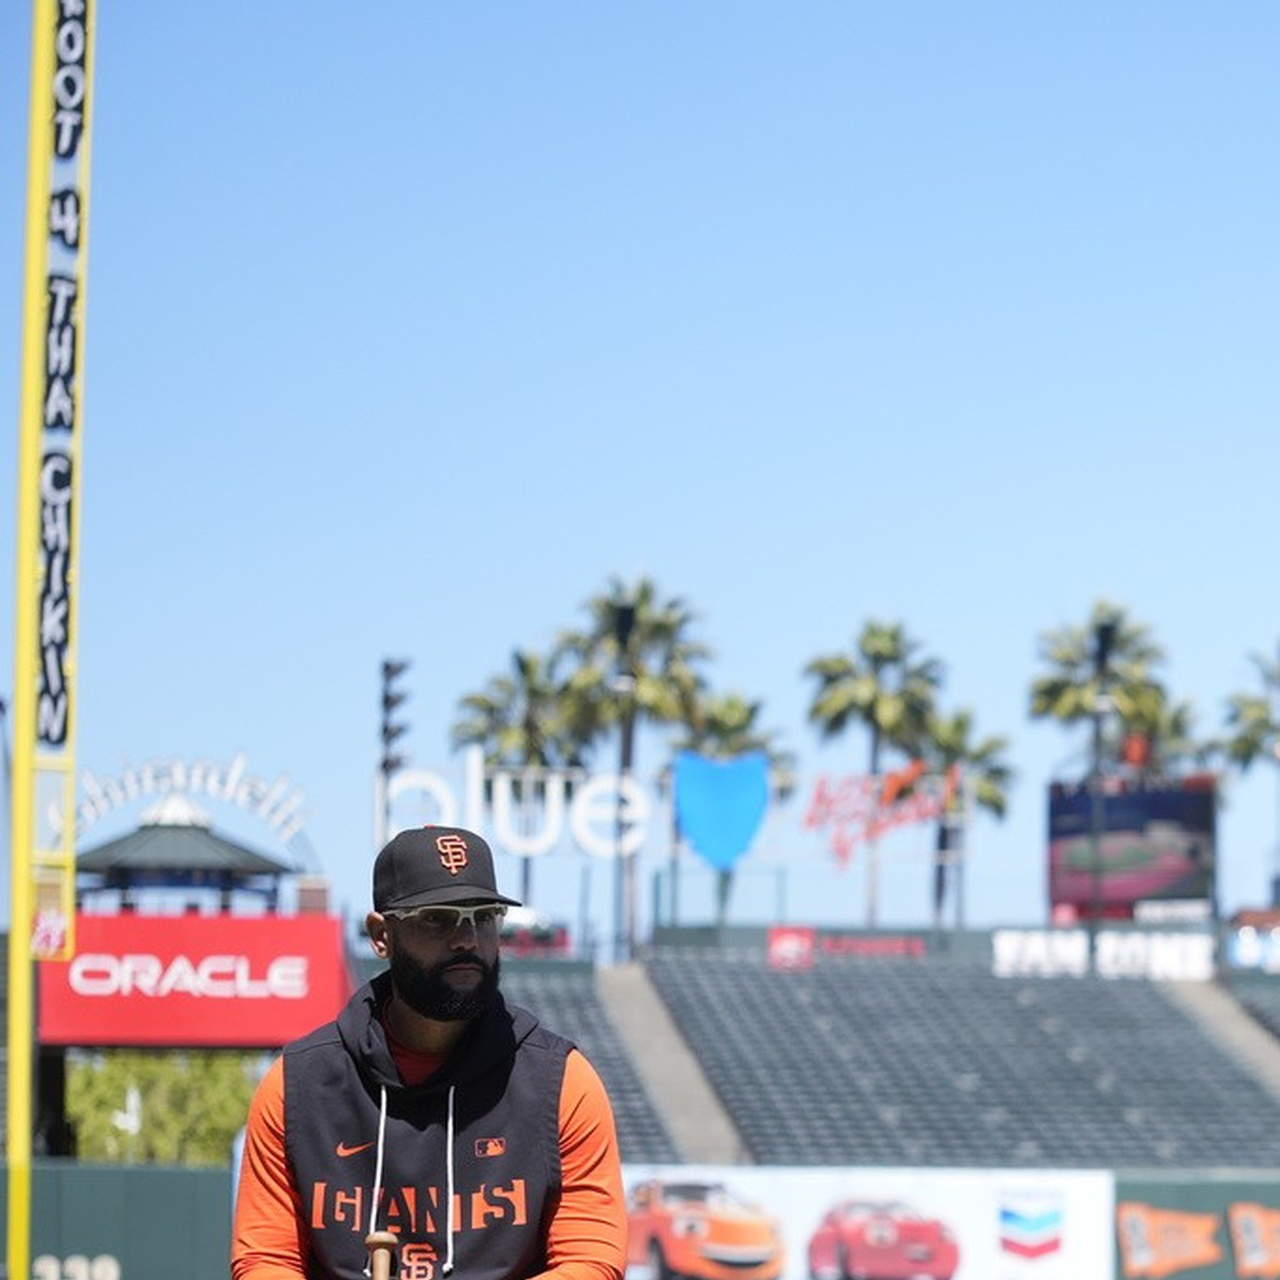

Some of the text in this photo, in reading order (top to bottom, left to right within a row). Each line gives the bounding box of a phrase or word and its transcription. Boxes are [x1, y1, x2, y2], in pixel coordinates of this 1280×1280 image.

[50, 191, 80, 249] 4
[48, 277, 77, 428] THA
[38, 452, 71, 744] CHIKIN
[373, 745, 652, 860] blue
[436, 834, 469, 876] SF
[69, 953, 309, 999] ORACLE
